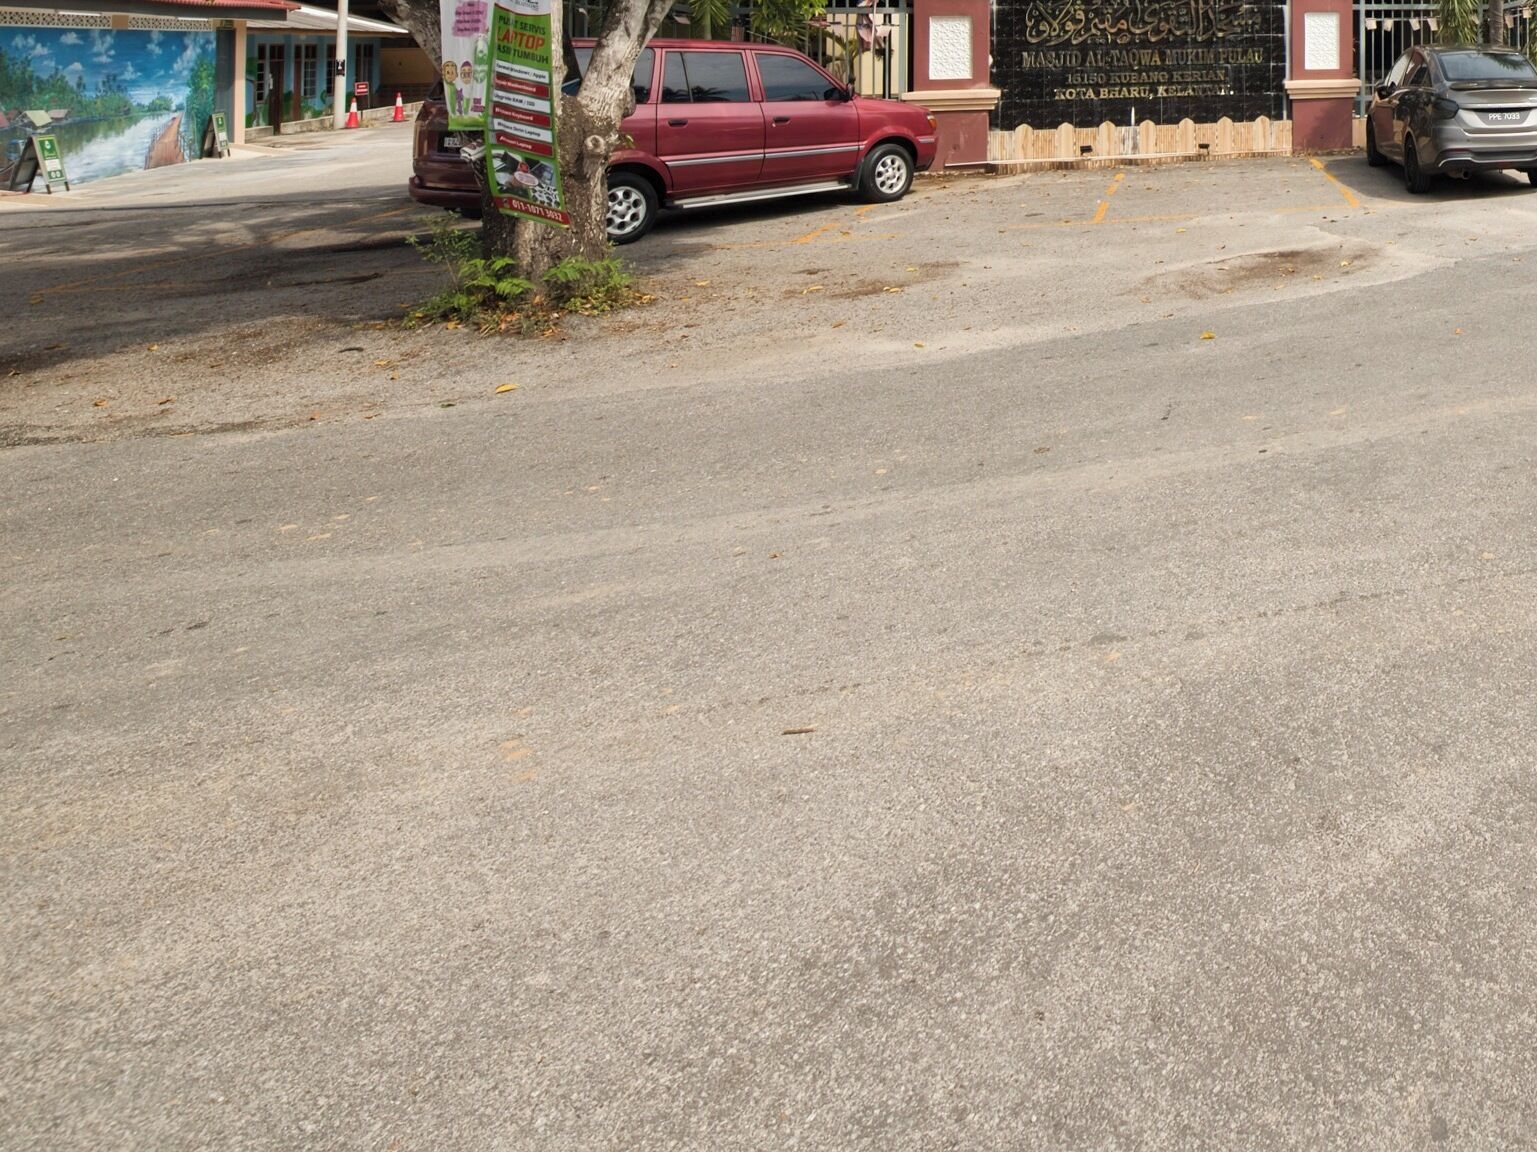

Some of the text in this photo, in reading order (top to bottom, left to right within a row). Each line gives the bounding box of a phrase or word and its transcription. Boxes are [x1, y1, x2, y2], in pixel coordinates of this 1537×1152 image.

[497, 27, 545, 51] LAPTOP
[512, 48, 549, 64] TUMBUH
[1022, 51, 1082, 68] MASJID
[1165, 49, 1216, 65] MUKIM
[1219, 48, 1264, 64] PULAU
[1066, 73, 1106, 85] 16150
[1109, 72, 1169, 84] KUBANG
[1054, 89, 1096, 101] KOTA
[1099, 87, 1153, 100] BHARU,
[1488, 111, 1520, 121] PPE 7033
